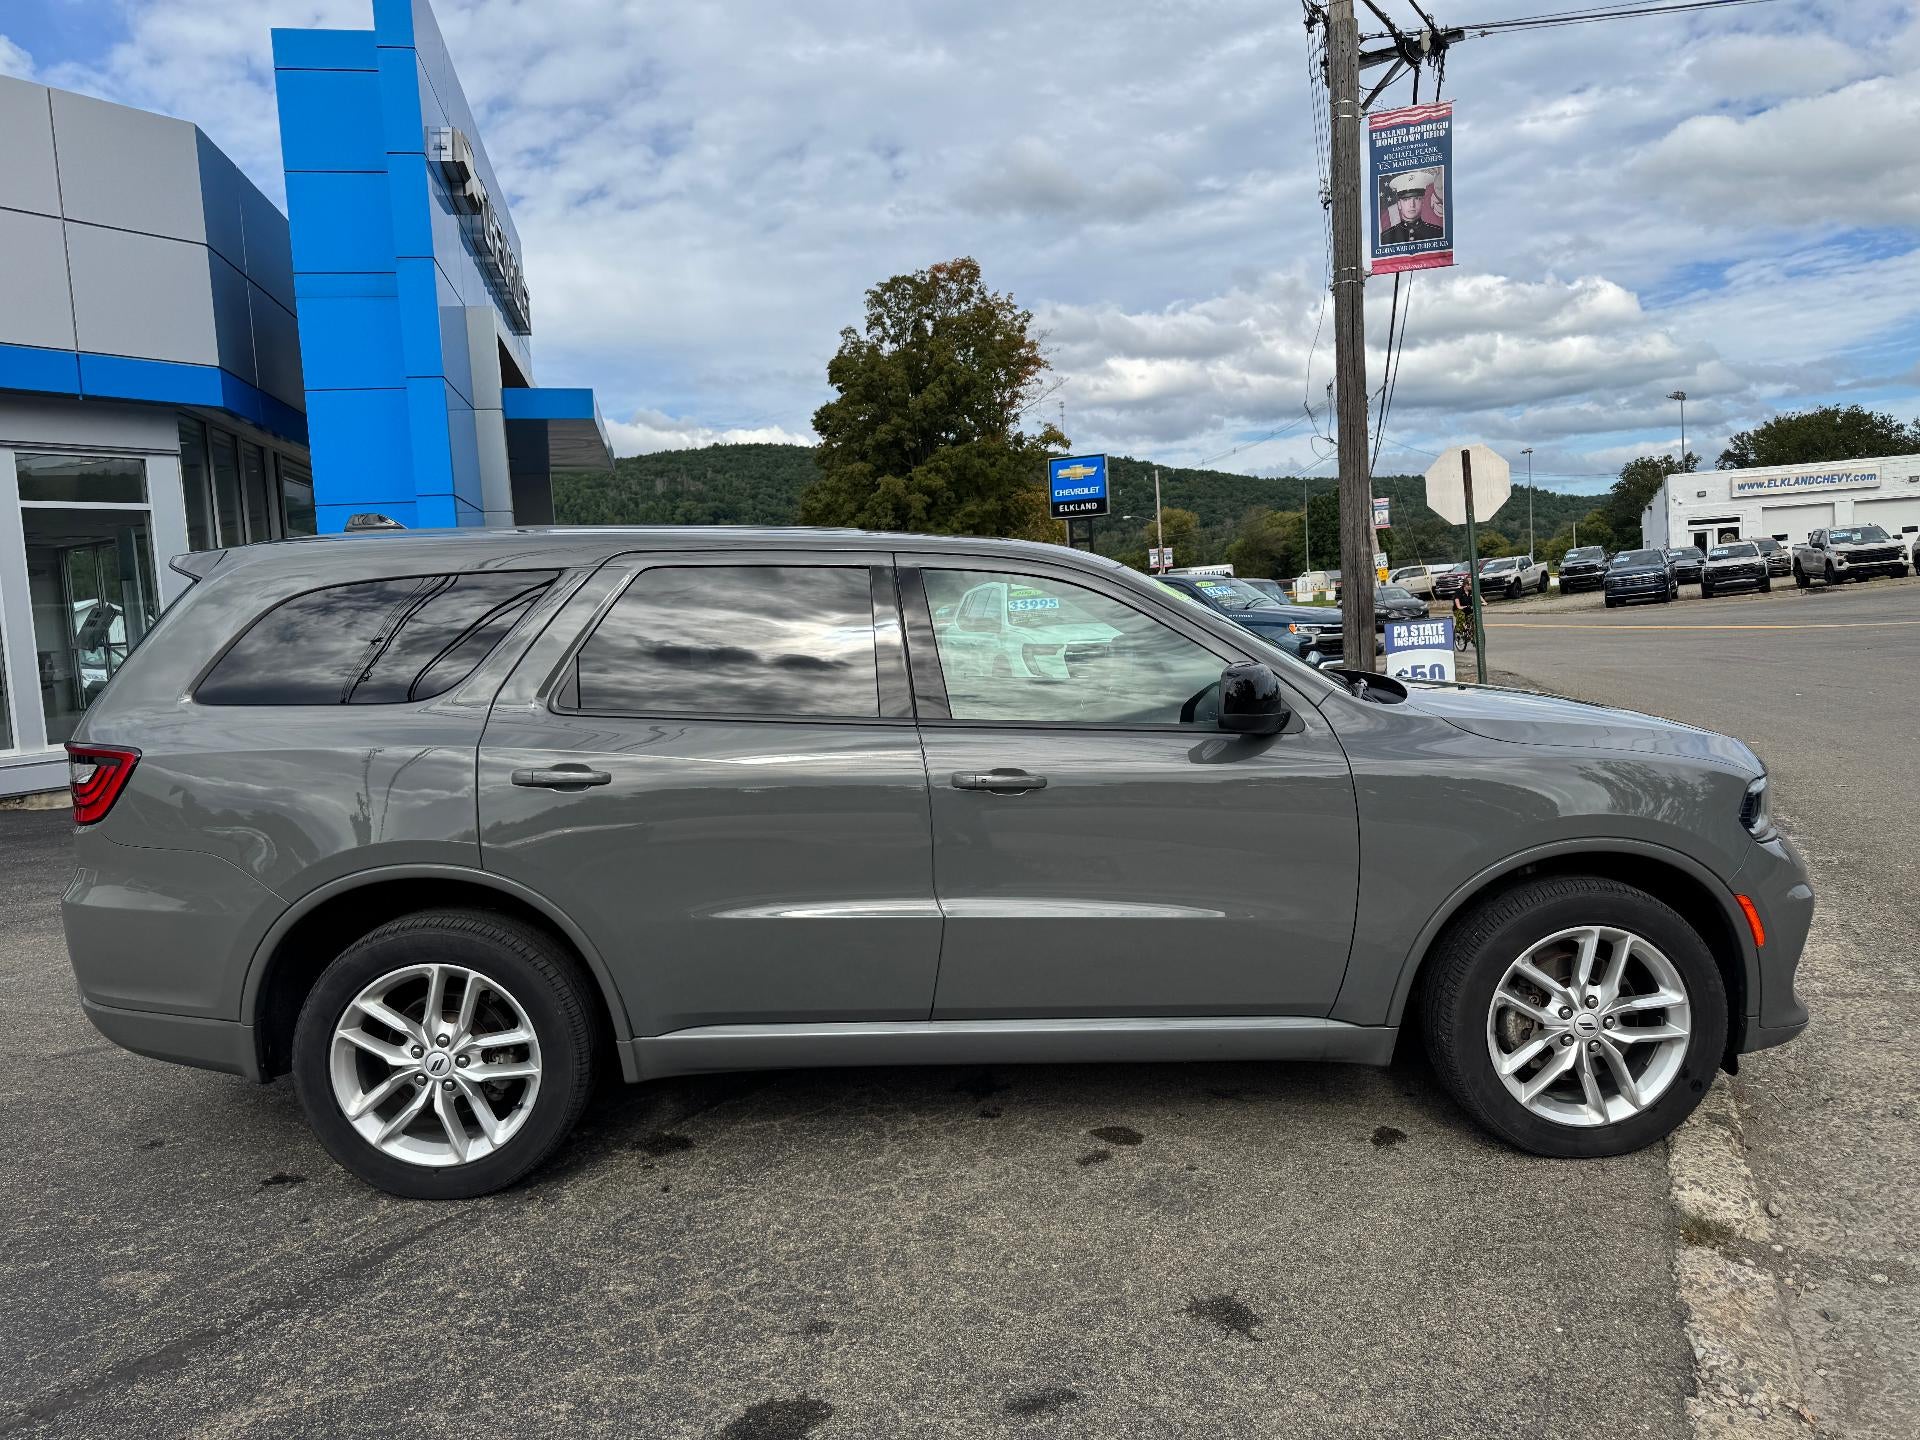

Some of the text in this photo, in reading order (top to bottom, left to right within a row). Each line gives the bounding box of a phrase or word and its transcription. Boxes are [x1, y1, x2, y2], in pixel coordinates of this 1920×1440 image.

[1372, 121, 1449, 140] ELKLAND BOROUGH
[1375, 129, 1446, 147] HOMETOWN HERO
[1383, 147, 1439, 161] MICHAEL PLANK
[1392, 158, 1420, 169] MARINE
[1420, 154, 1443, 164] CORPS
[1737, 472, 1877, 491] www.ELKLANDCHEVY.com
[1054, 486, 1100, 497] CHEVROLET
[1059, 502, 1098, 512] ELKLAND
[1009, 598, 1058, 611] 33995
[1393, 622, 1445, 638] PA STATE
[1394, 634, 1446, 647] INSPECTION
